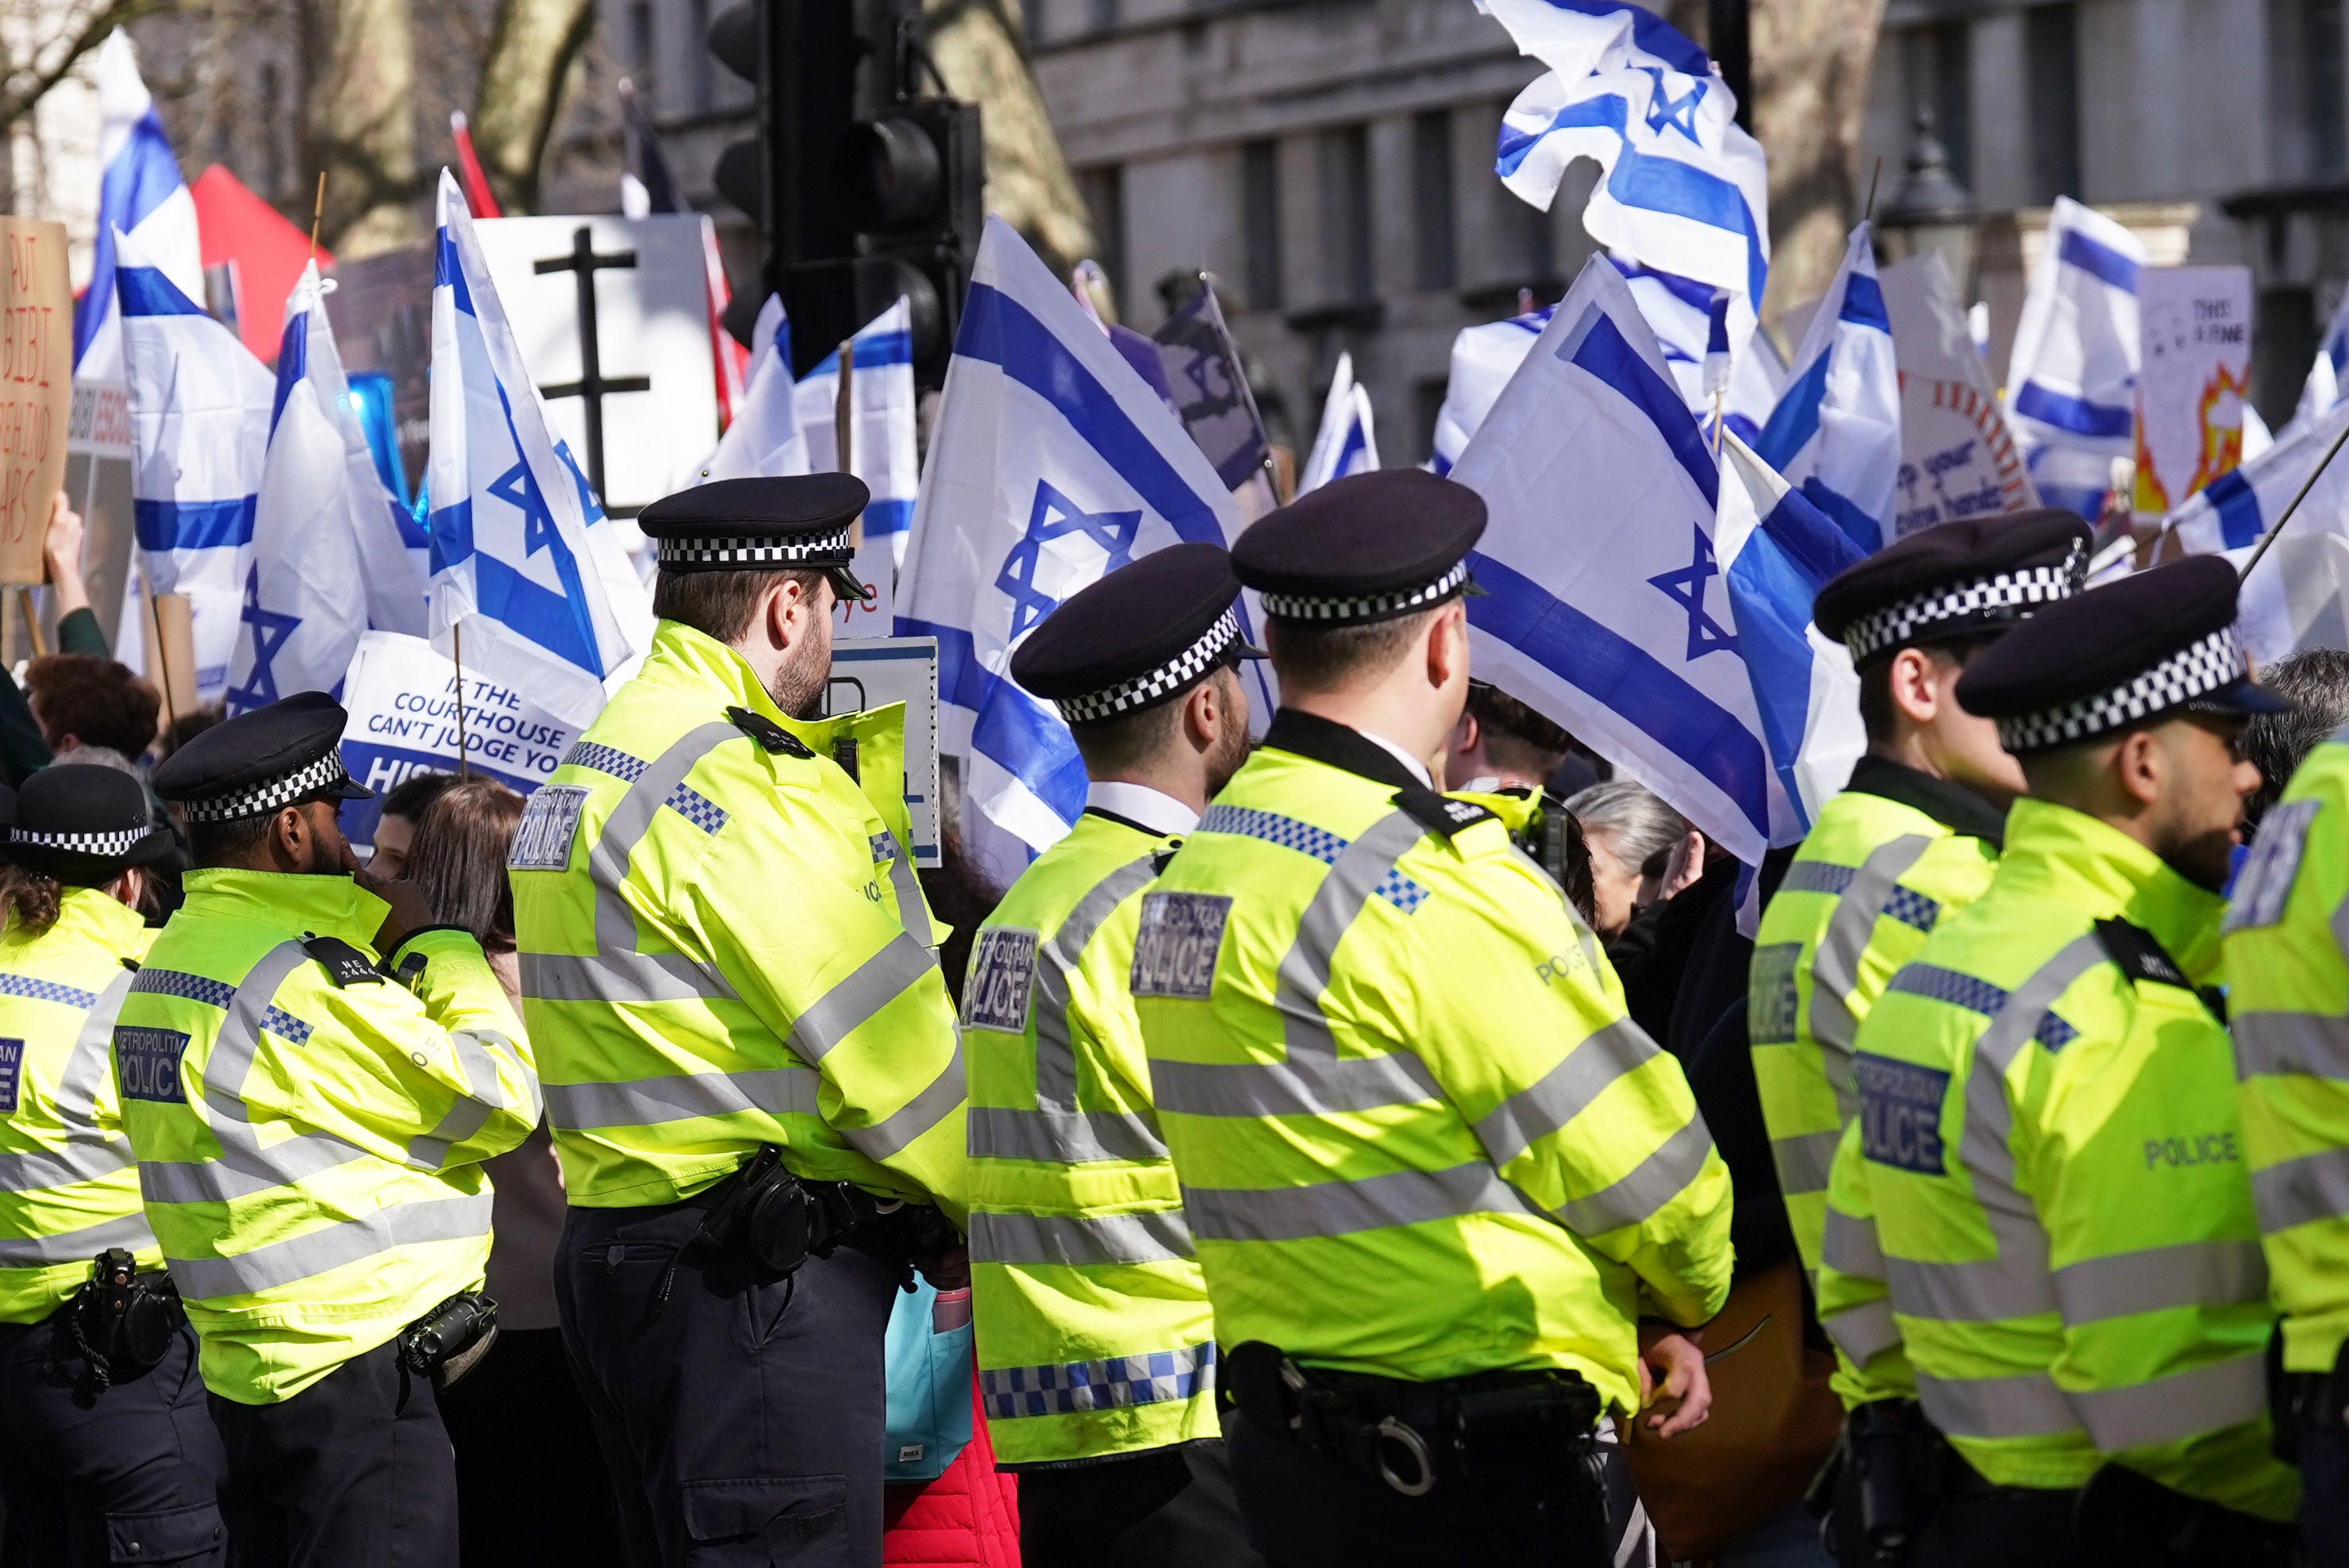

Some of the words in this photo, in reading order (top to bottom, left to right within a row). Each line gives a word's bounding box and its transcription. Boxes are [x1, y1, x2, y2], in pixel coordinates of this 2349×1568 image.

[0, 402, 50, 463] EHIND
[444, 676, 468, 694] IF
[475, 681, 521, 712] THE
[368, 714, 433, 740] CAN'T
[431, 726, 520, 764] JUDGE
[394, 692, 566, 750] COURTHOUSE
[2144, 1131, 2241, 1170] POLICE
